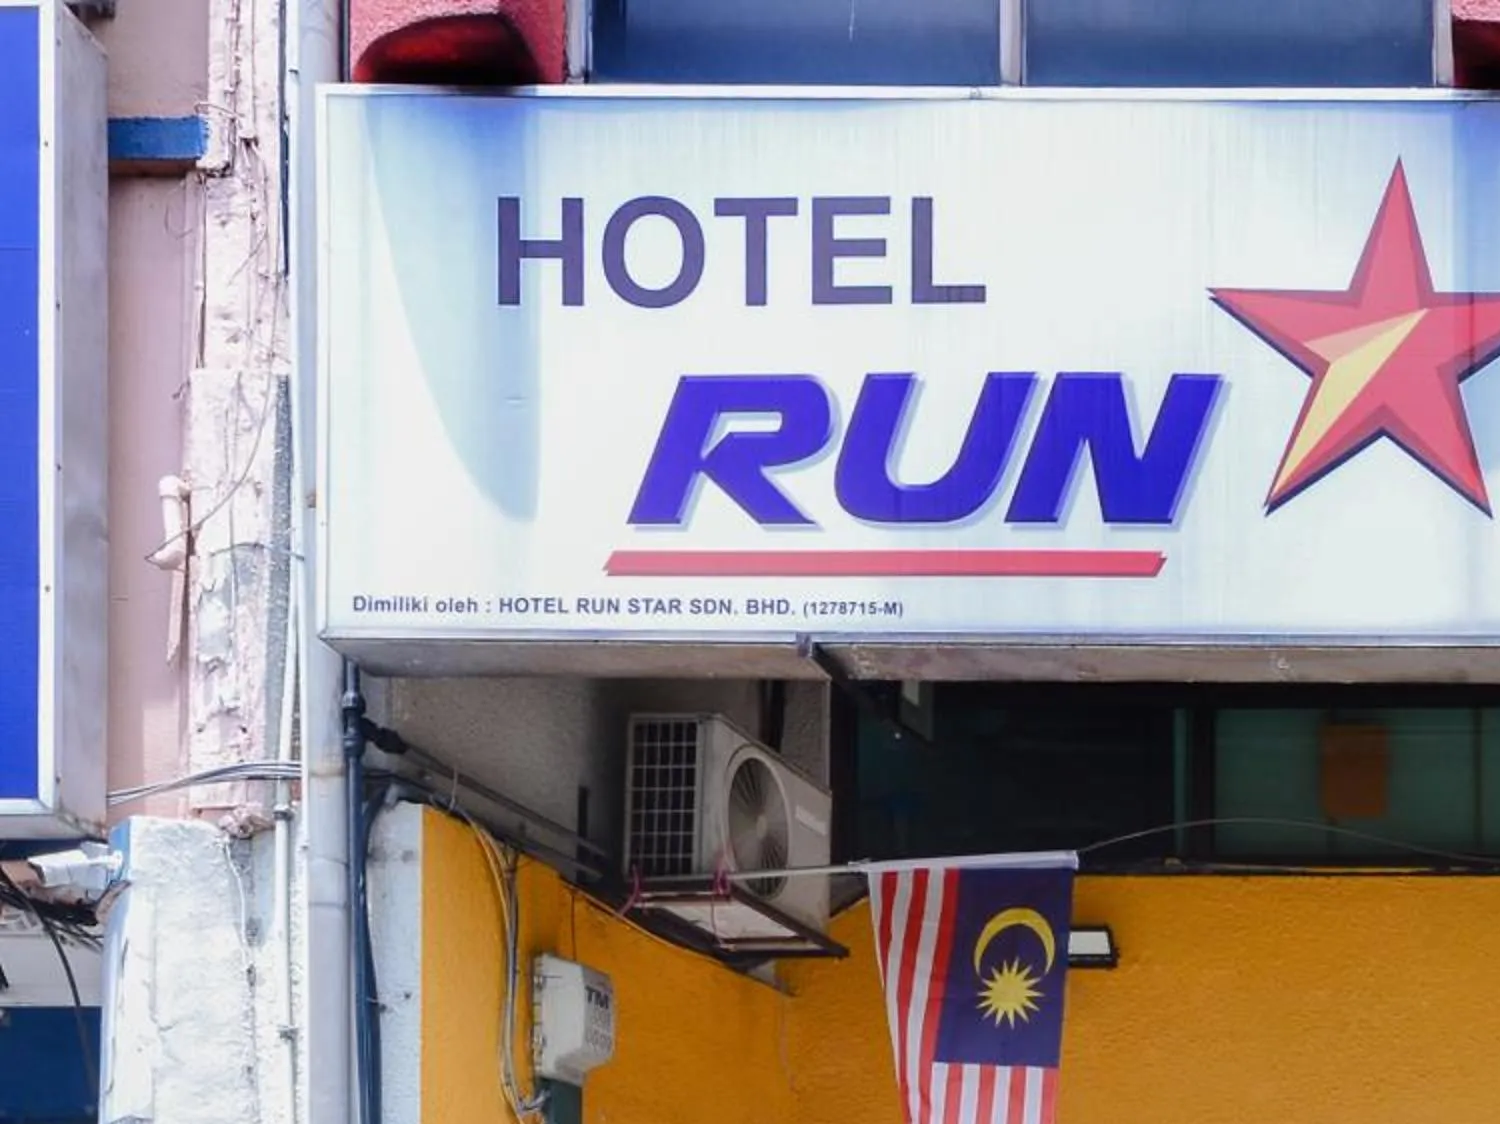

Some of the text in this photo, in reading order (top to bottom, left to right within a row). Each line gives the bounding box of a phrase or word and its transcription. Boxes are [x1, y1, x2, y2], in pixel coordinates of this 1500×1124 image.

[498, 195, 986, 308] HOTEL
[626, 372, 1230, 530] RUN
[352, 595, 428, 613] Dimiliki
[435, 597, 478, 613] oleh
[499, 597, 568, 614] HOTEL
[576, 598, 620, 614] RUN
[628, 598, 682, 615] STAR
[689, 598, 738, 615] SDN.
[746, 599, 796, 615] BHD.
[803, 601, 904, 617] (1278715-M)
